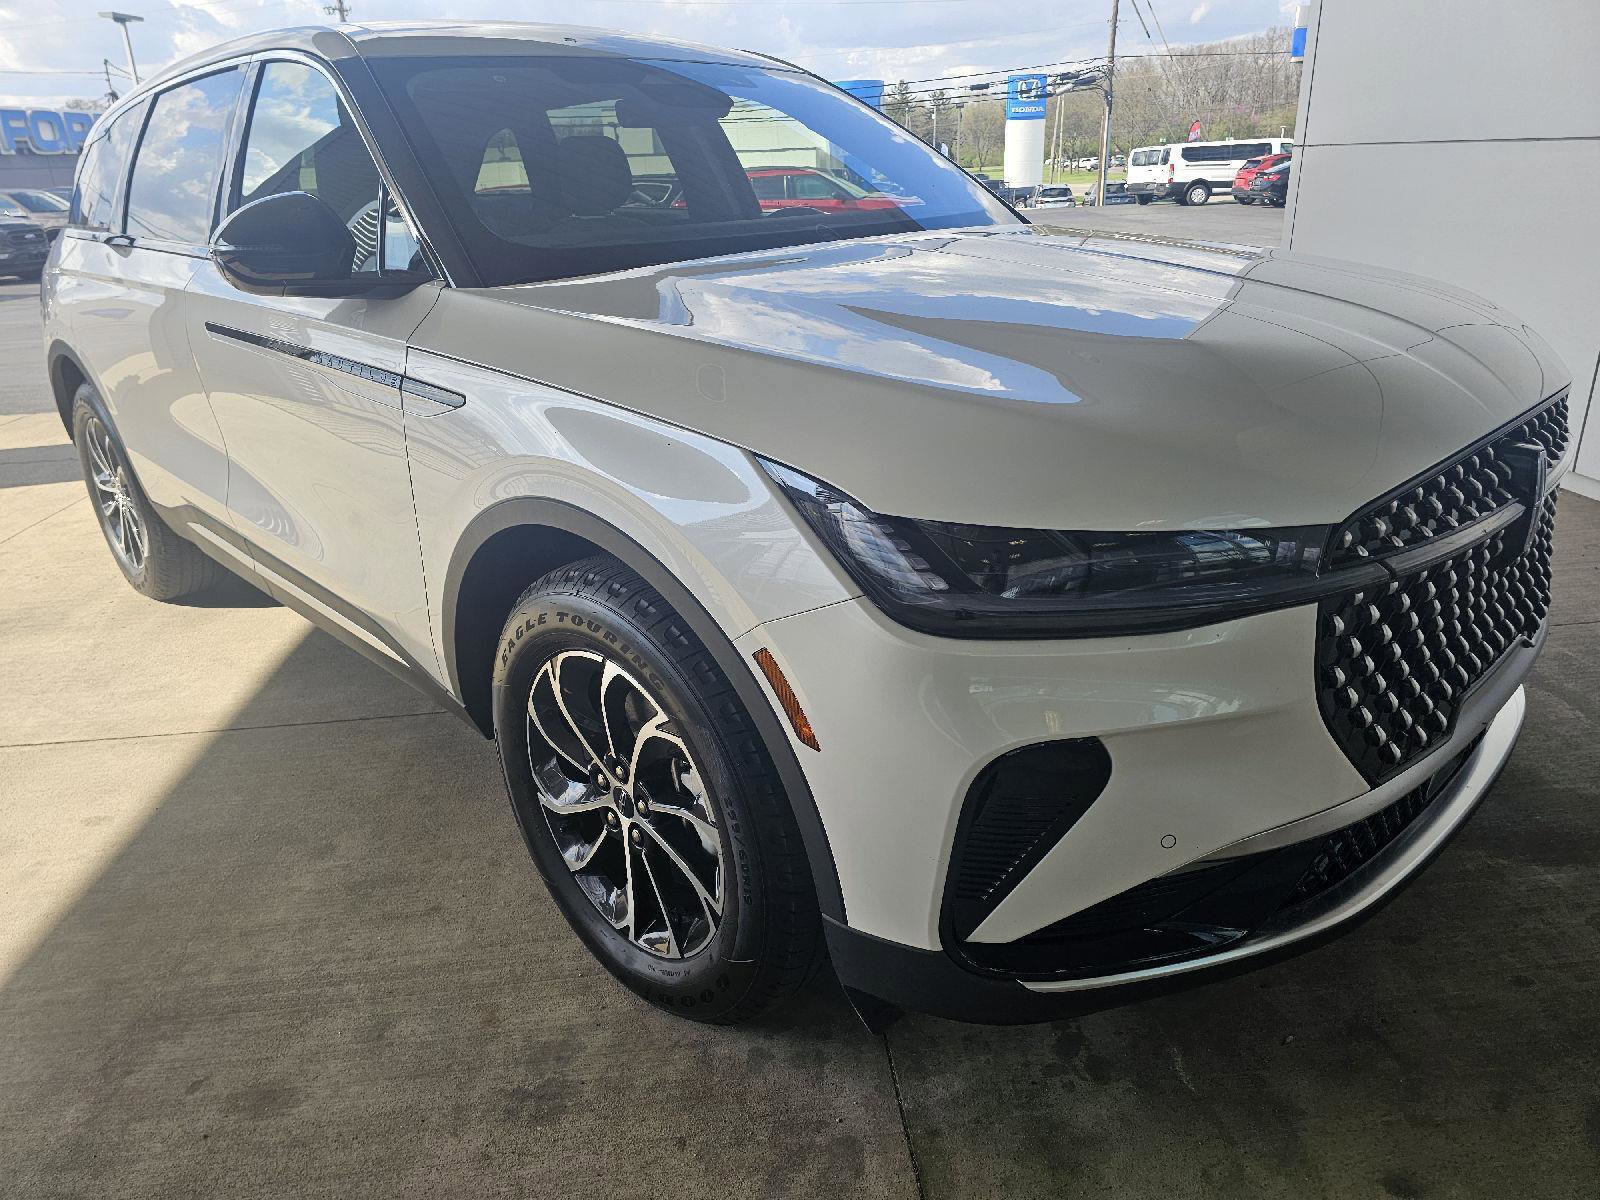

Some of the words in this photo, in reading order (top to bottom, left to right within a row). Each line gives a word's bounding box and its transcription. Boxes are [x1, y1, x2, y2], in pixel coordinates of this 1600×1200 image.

[0, 108, 101, 155] FOR
[501, 611, 548, 668] EAGLE
[555, 611, 665, 691] TOURING
